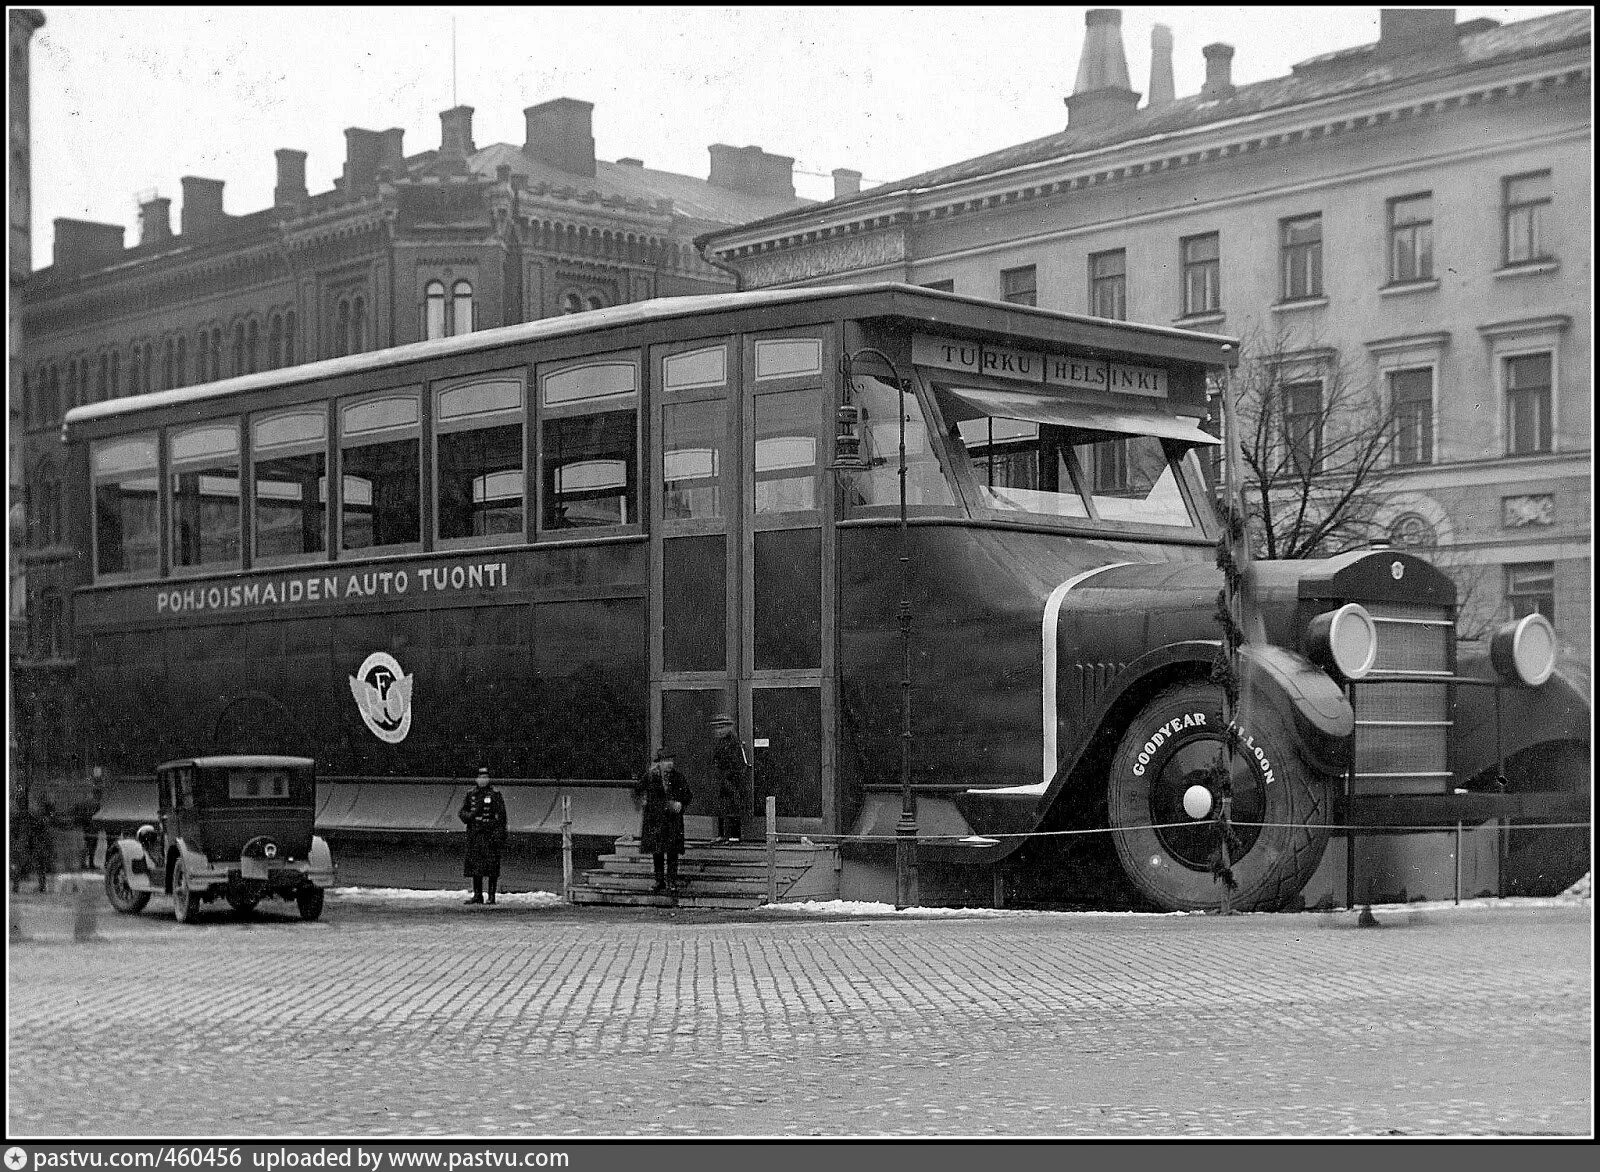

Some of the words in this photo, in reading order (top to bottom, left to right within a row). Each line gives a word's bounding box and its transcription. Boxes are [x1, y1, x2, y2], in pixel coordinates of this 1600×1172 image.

[941, 345, 1032, 374] TURKU
[1054, 358, 1160, 391] HELSINKI
[157, 577, 339, 613] POHJOISMAIDEN
[345, 571, 408, 597] AUTO
[418, 562, 507, 591] TUONTI
[1132, 713, 1207, 776] GOODYEAR
